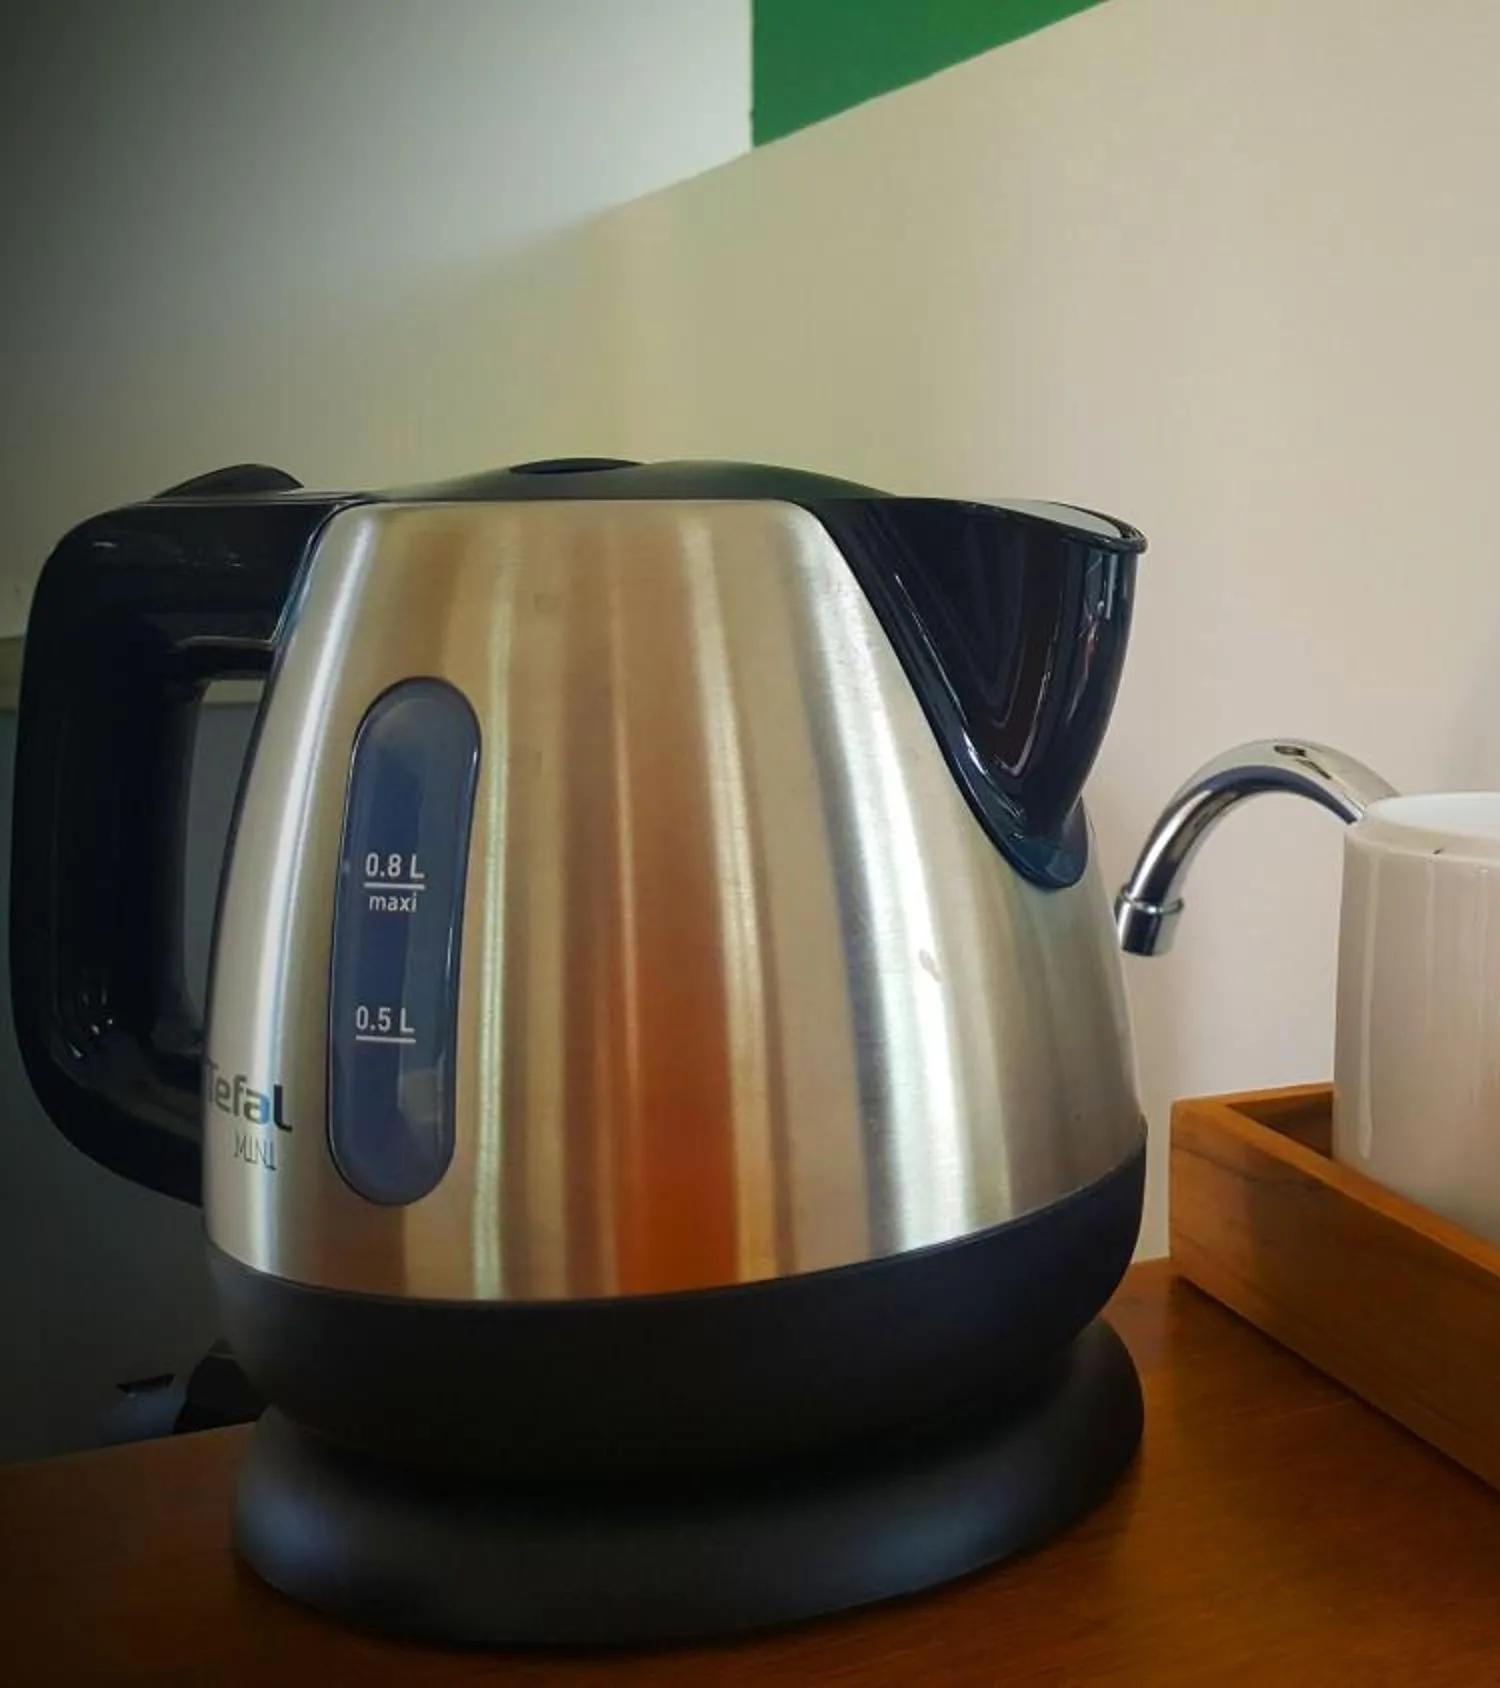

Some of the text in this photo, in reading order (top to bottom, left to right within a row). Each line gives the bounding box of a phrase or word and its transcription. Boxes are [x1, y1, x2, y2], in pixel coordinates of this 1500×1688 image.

[365, 852, 425, 879] 0.8 L
[369, 891, 418, 912] maxi
[356, 1005, 415, 1033] 0.5 L
